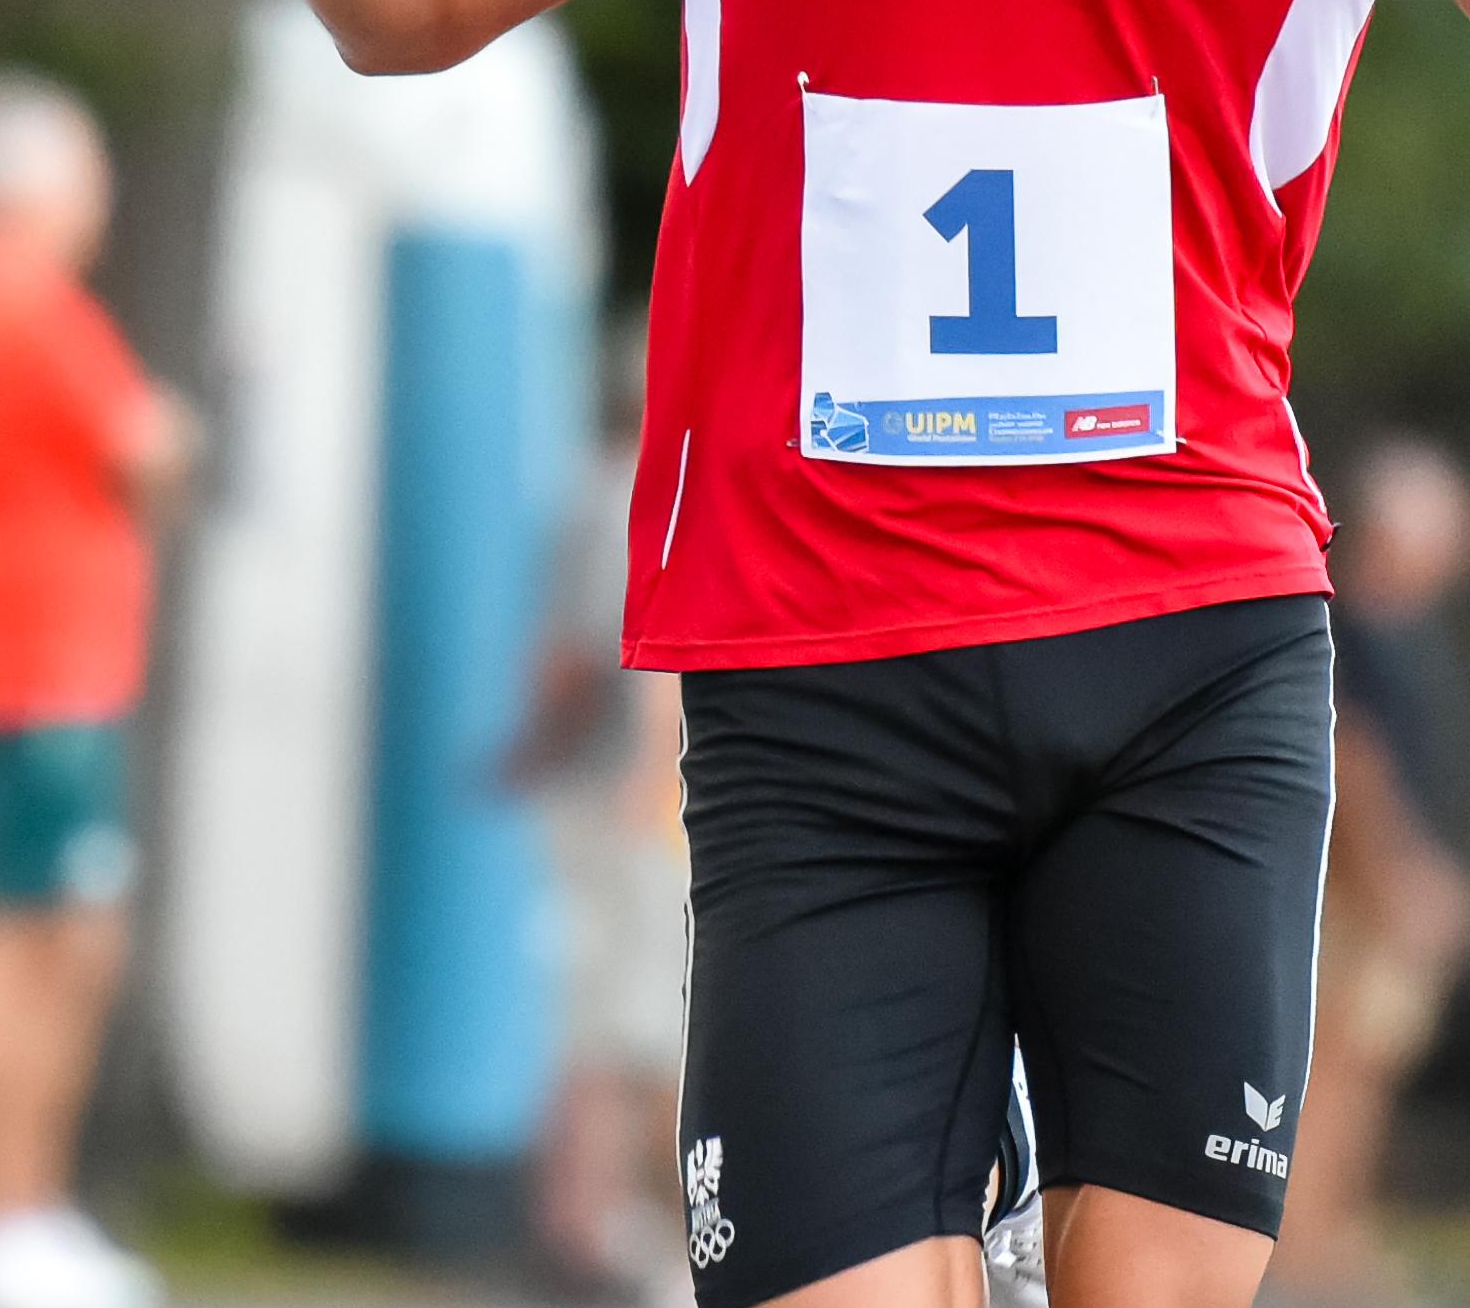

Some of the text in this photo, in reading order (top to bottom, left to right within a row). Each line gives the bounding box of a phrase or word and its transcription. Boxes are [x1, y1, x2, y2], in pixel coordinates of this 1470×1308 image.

[922, 169, 1058, 354] 1
[905, 411, 977, 434] UIPM
[1205, 1134, 1288, 1180] erima
